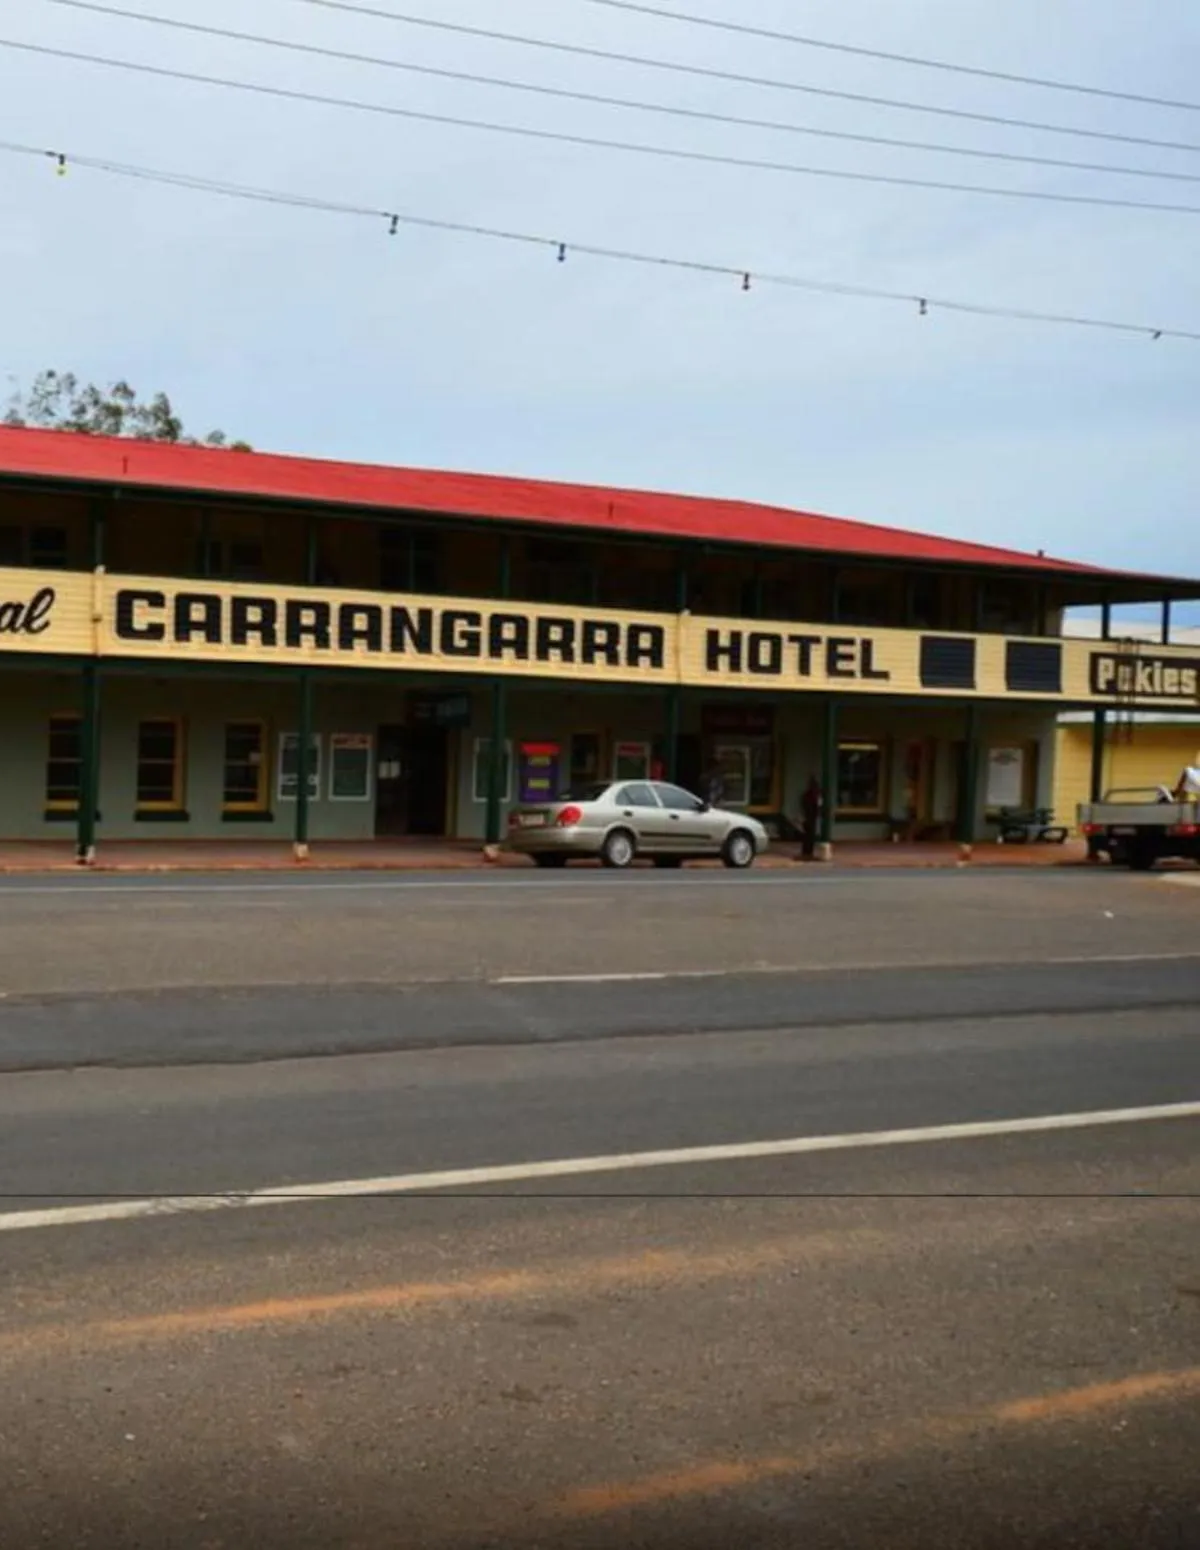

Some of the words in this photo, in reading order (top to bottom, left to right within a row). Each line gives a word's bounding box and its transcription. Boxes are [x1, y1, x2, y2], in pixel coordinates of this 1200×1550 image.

[114, 589, 665, 669] CARRANGARRA
[706, 629, 890, 681] HOTEL
[1097, 657, 1198, 694] Pokies
